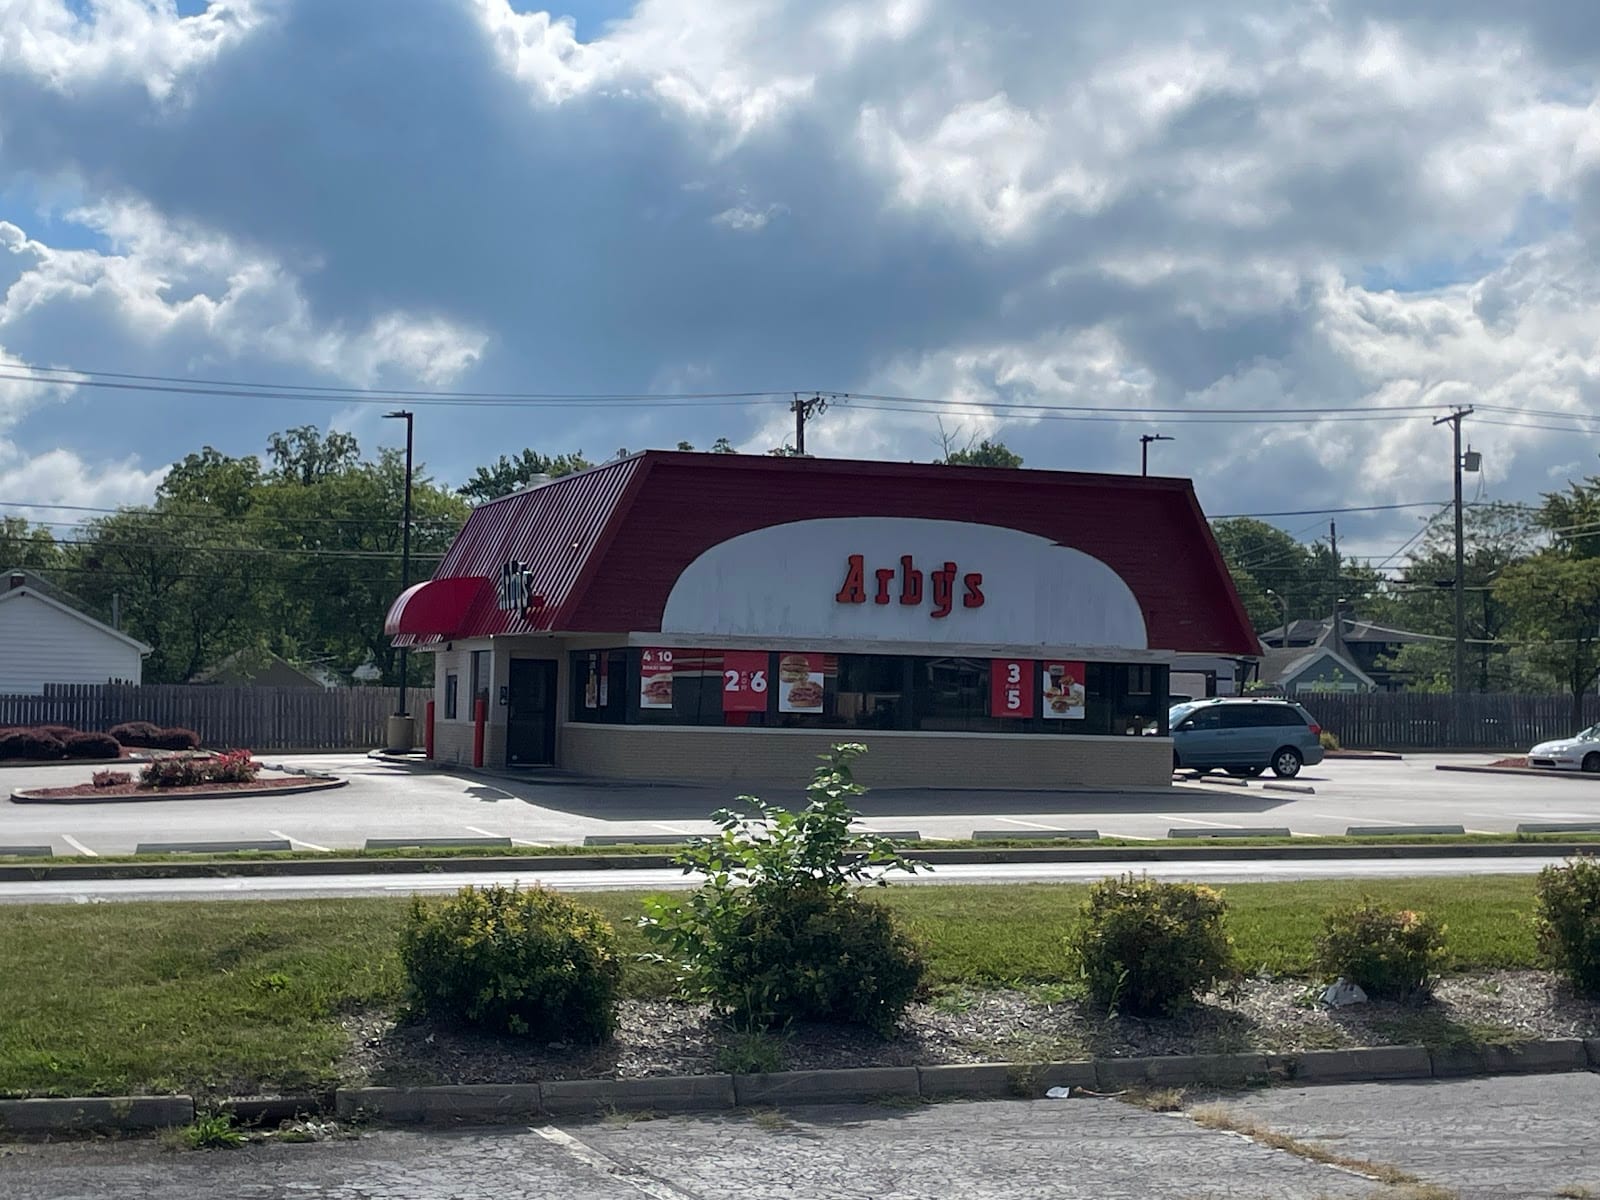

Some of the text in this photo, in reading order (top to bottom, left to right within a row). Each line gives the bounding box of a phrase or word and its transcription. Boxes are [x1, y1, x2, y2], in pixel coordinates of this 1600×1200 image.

[836, 554, 985, 618] Arby's
[642, 650, 652, 662] 4
[724, 670, 740, 692] 2
[1007, 663, 1021, 683] 3
